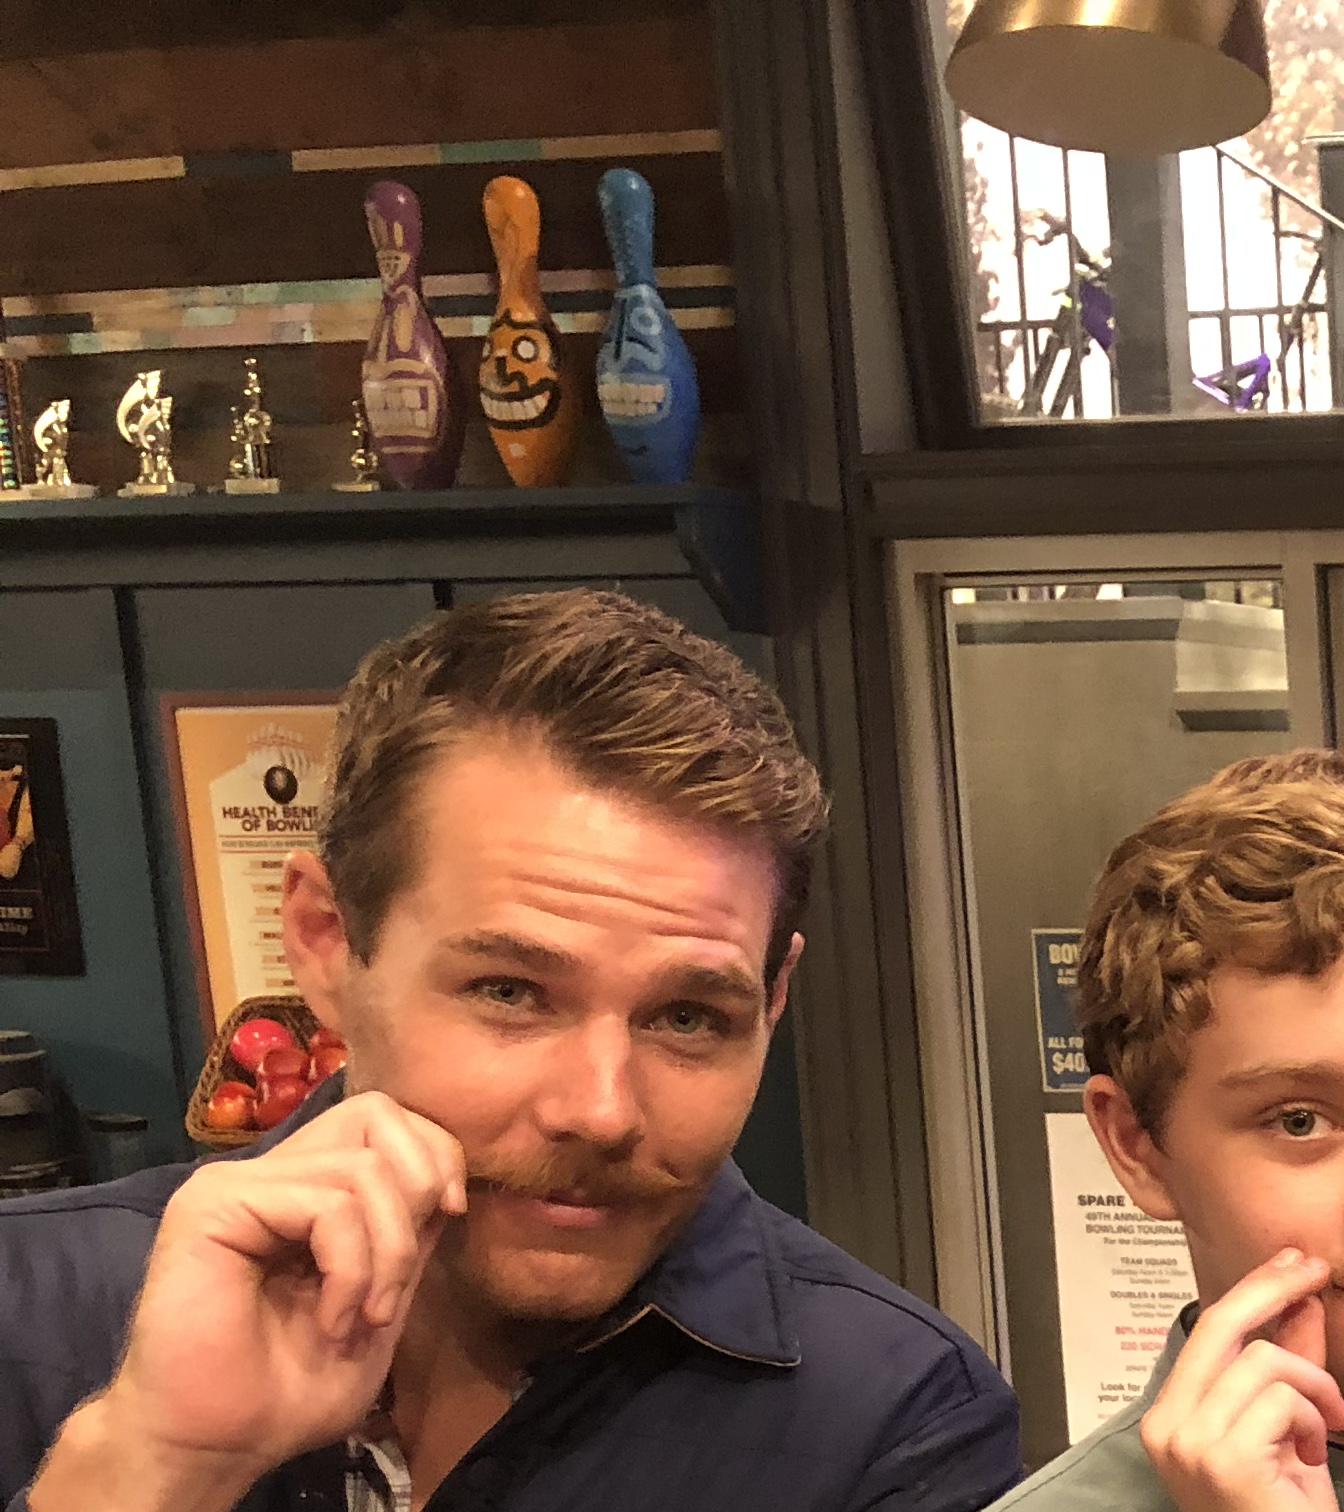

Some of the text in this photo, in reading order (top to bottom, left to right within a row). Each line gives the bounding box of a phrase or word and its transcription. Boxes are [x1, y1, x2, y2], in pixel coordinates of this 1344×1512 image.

[222, 805, 277, 818] HEALTH
[241, 819, 261, 832] OF
[1077, 1194, 1126, 1207] SPARE
[1085, 1223, 1135, 1235] BOWLING
[1100, 1381, 1141, 1392] Look for
